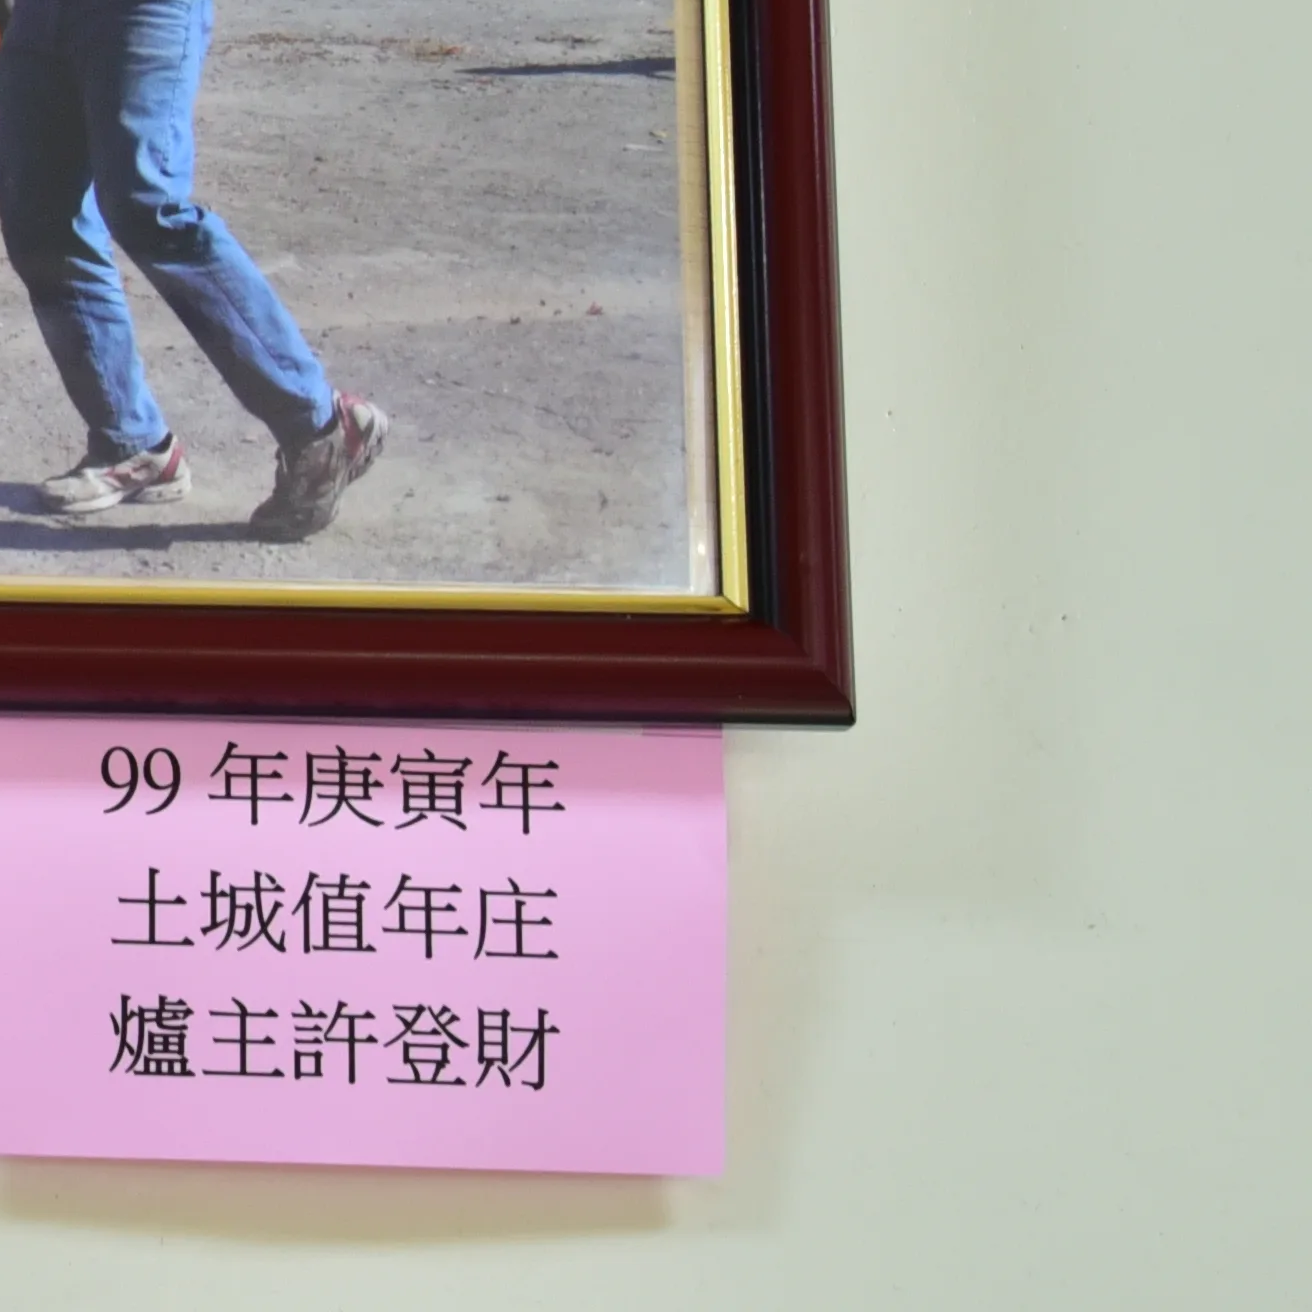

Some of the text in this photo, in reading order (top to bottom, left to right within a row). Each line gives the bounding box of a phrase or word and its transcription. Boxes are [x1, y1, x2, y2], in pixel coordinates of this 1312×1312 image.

[100, 741, 566, 835] 99 年庚寅年
[111, 867, 559, 960] 土城值年庄
[109, 994, 560, 1091] 爐主許登財
